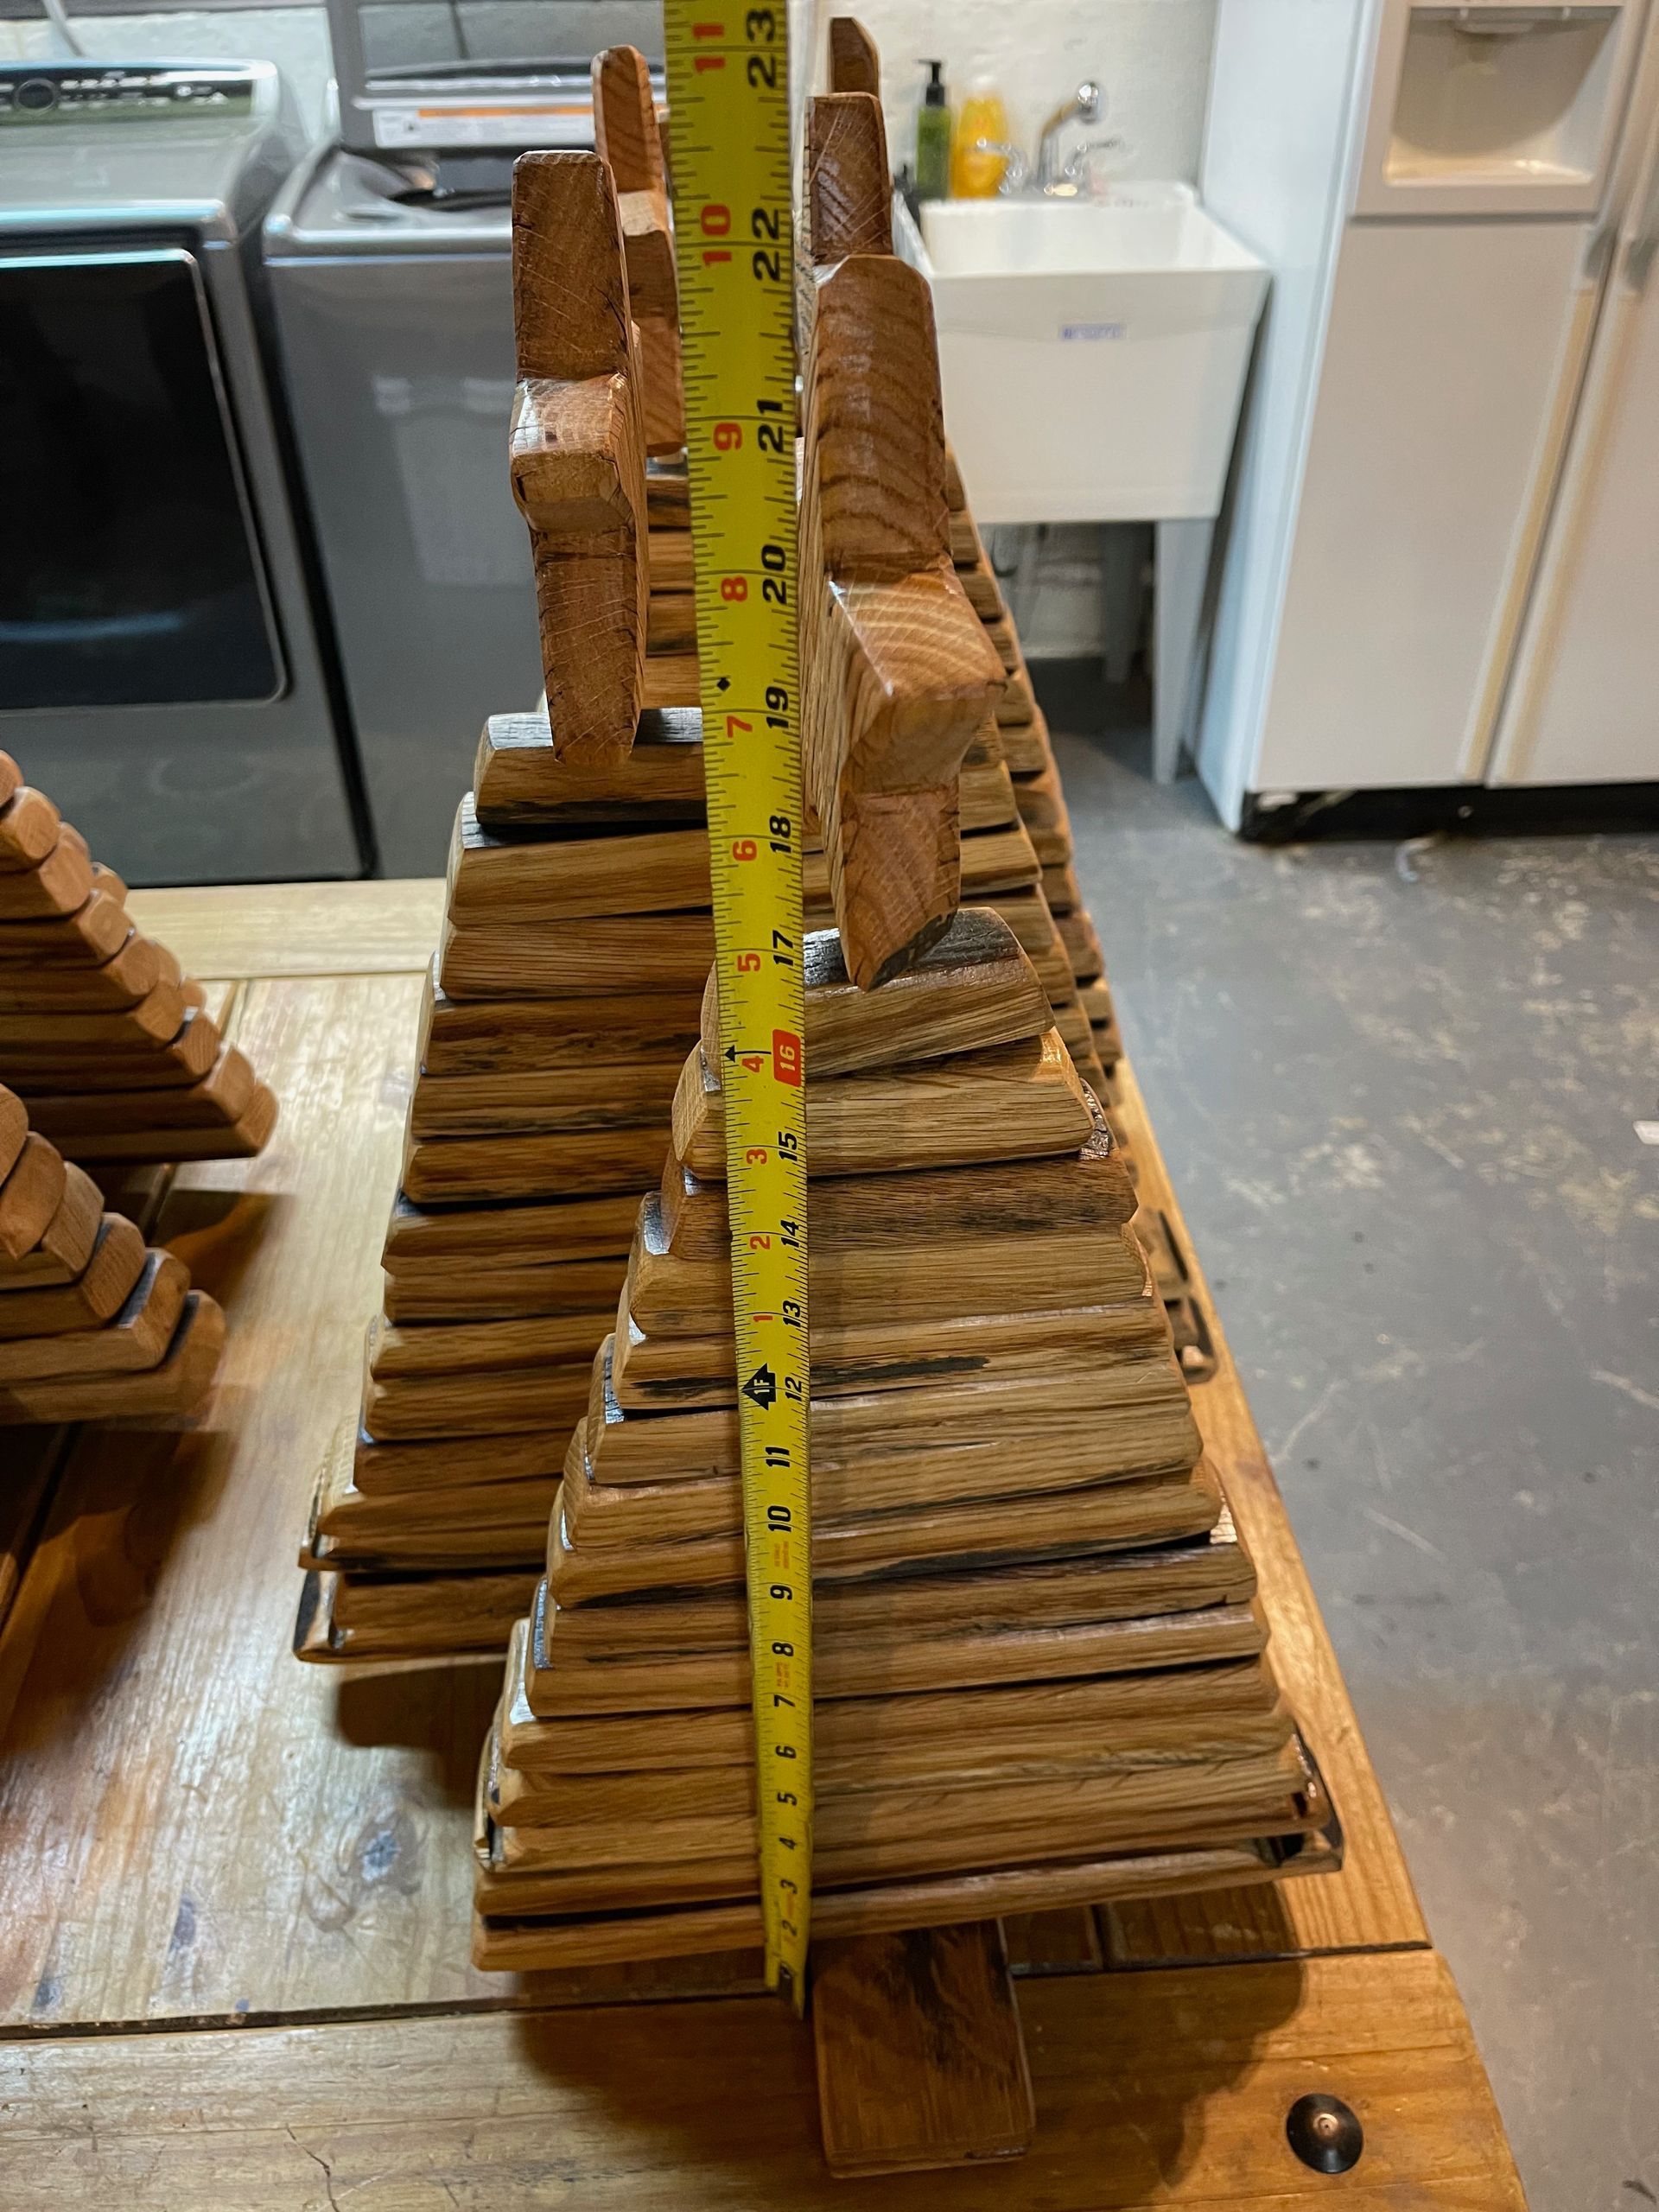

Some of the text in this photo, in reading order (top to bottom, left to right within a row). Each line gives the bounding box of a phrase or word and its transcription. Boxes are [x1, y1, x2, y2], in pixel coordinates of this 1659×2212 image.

[747, 10, 777, 88] 23
[752, 208, 780, 282] 22
[714, 422, 743, 451] 9
[757, 399, 785, 454] 21
[761, 544, 787, 604] 20
[721, 575, 748, 603] 8
[766, 686, 789, 729] 19
[727, 715, 753, 738] 7
[769, 815, 792, 854] 18
[733, 840, 757, 861] 6
[772, 930, 793, 966] 17
[737, 953, 760, 972] 5
[741, 1055, 764, 1073] 4
[779, 1044, 796, 1071] 16
[747, 1148, 767, 1165] 3
[779, 1131, 798, 1162] 15
[749, 1236, 770, 1250] 2
[780, 1219, 799, 1248] 14
[783, 1300, 801, 1328] 13
[785, 1376, 802, 1402] 12
[765, 1446, 790, 1468] 11
[767, 1505, 791, 1533] 10
[770, 1585, 792, 1600] 9
[772, 1642, 794, 1657] 8
[773, 1694, 796, 1707] 7
[775, 1745, 797, 1759] 6
[777, 1792, 798, 1806] 5
[779, 1837, 798, 1850] 4
